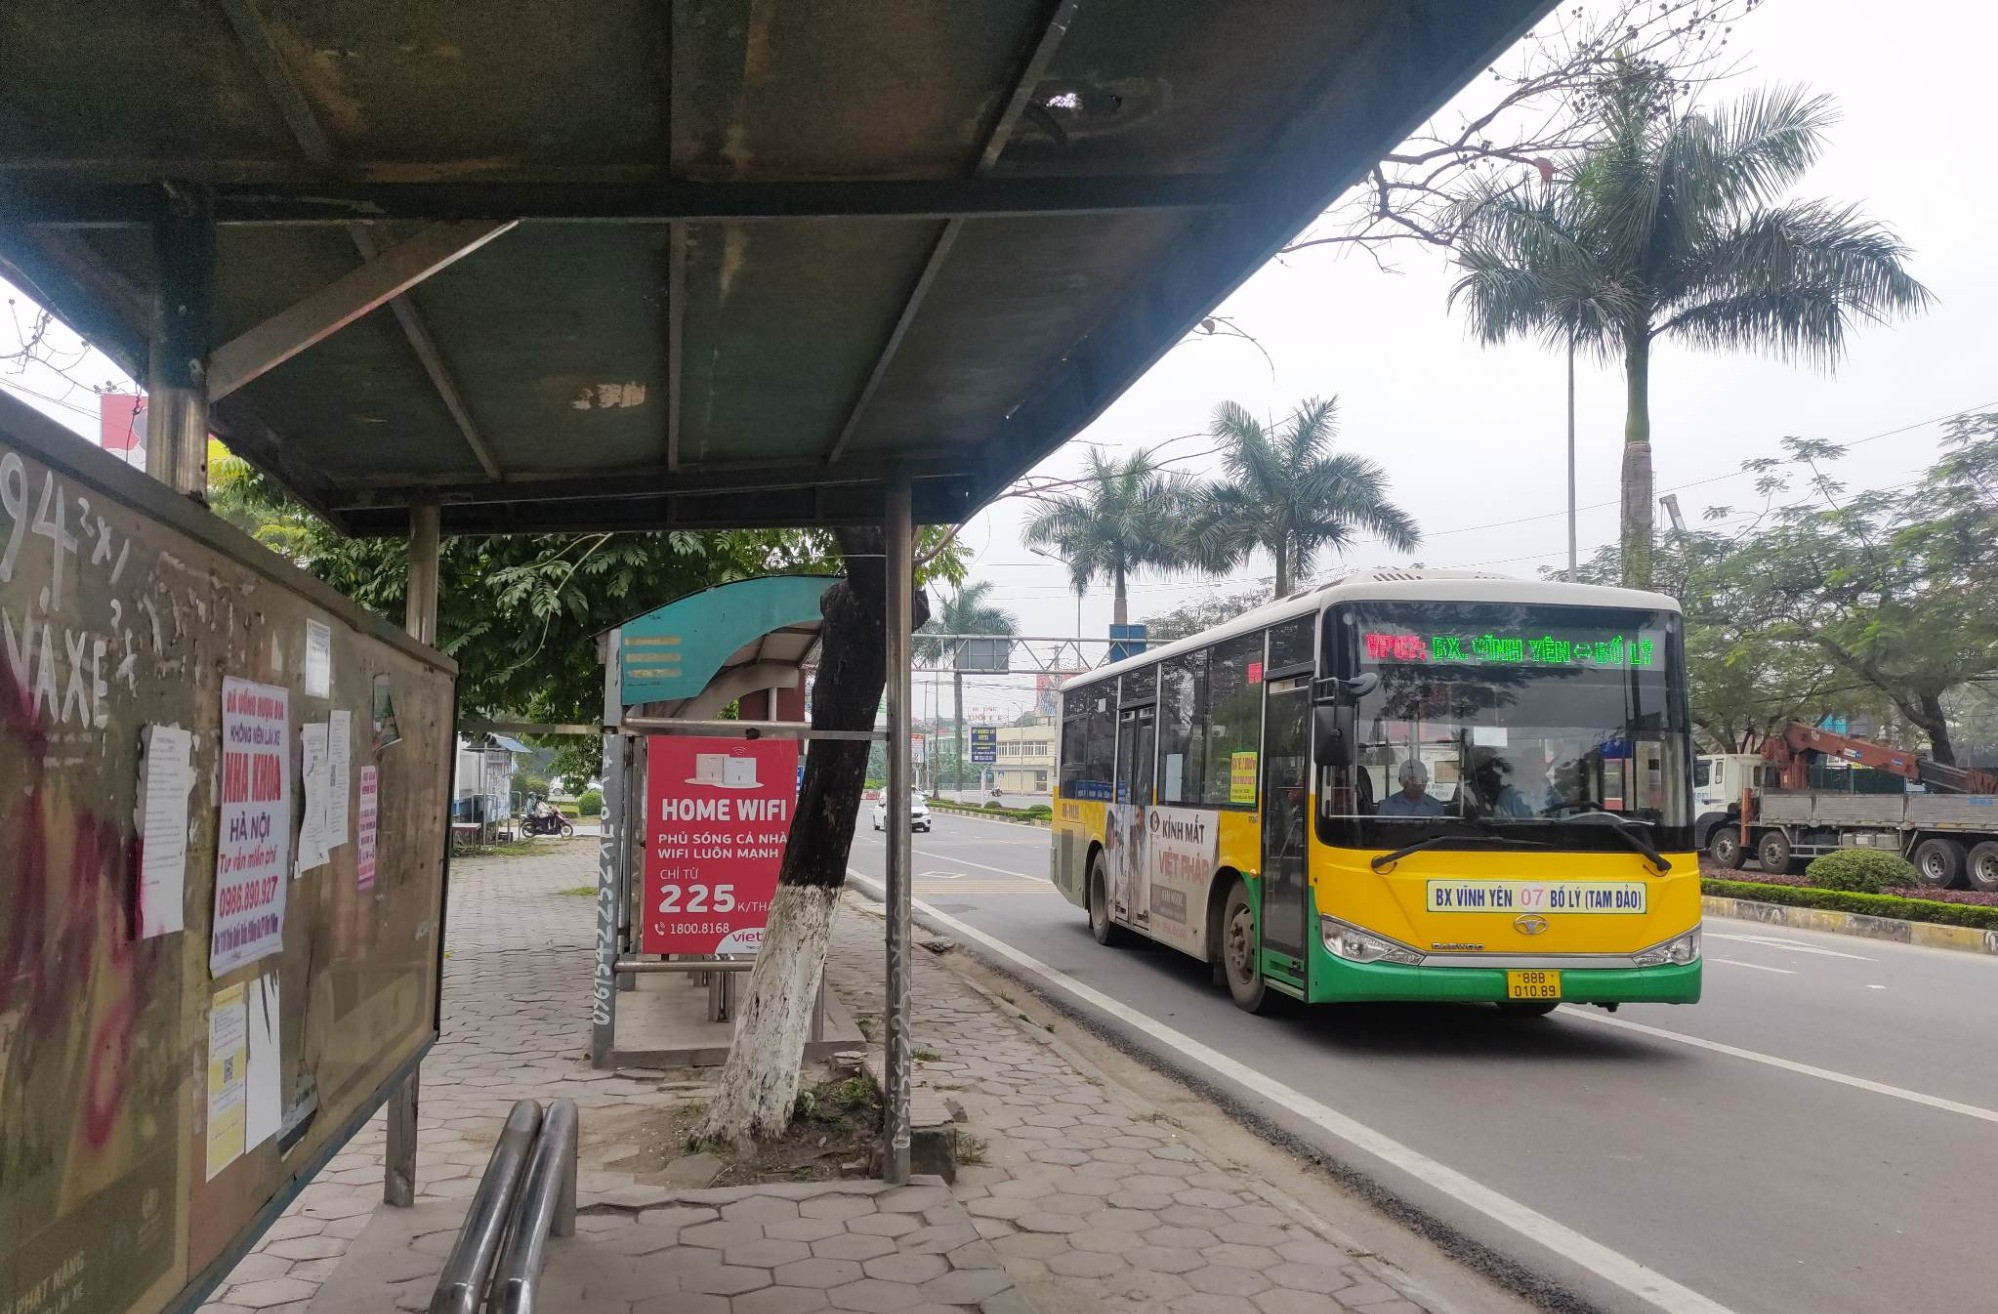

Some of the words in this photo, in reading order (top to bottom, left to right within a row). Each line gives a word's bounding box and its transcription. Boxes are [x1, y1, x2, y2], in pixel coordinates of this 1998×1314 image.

[230, 722, 252, 743] KHÔNG
[223, 752, 249, 803] NHA
[251, 753, 282, 803] KHOA
[662, 799, 730, 821] HOME
[737, 799, 786, 821] WIFI
[230, 810, 247, 842] HÀ
[250, 812, 270, 843] NỘI
[1162, 814, 1183, 841] KÍNH
[1185, 814, 1205, 845] MẮT
[658, 831, 688, 844] PHỦ
[693, 831, 732, 844] SÓNG
[736, 831, 754, 844] CẢ
[759, 831, 787, 844] NHÀ
[658, 848, 689, 859] WIFI
[694, 846, 732, 859] LUÔN
[737, 848, 779, 861] MẠNH
[660, 866, 680, 880] CHỈ
[683, 867, 699, 879] TỪ
[219, 876, 278, 918] 0986.890.927
[658, 884, 735, 913] 225
[1436, 888, 1452, 907] BX
[1456, 885, 1485, 907] VĨNH
[1490, 885, 1513, 908] YÊN
[1520, 889, 1544, 906] 07
[1550, 885, 1566, 908] BỐ
[1568, 886, 1582, 908] LÝ
[1585, 889, 1613, 910] (TAM
[1616, 884, 1642, 910] ĐẢO)
[670, 922, 730, 934] 1800.8168
[1522, 972, 1546, 984] 88B
[1514, 985, 1556, 997] 010.89
